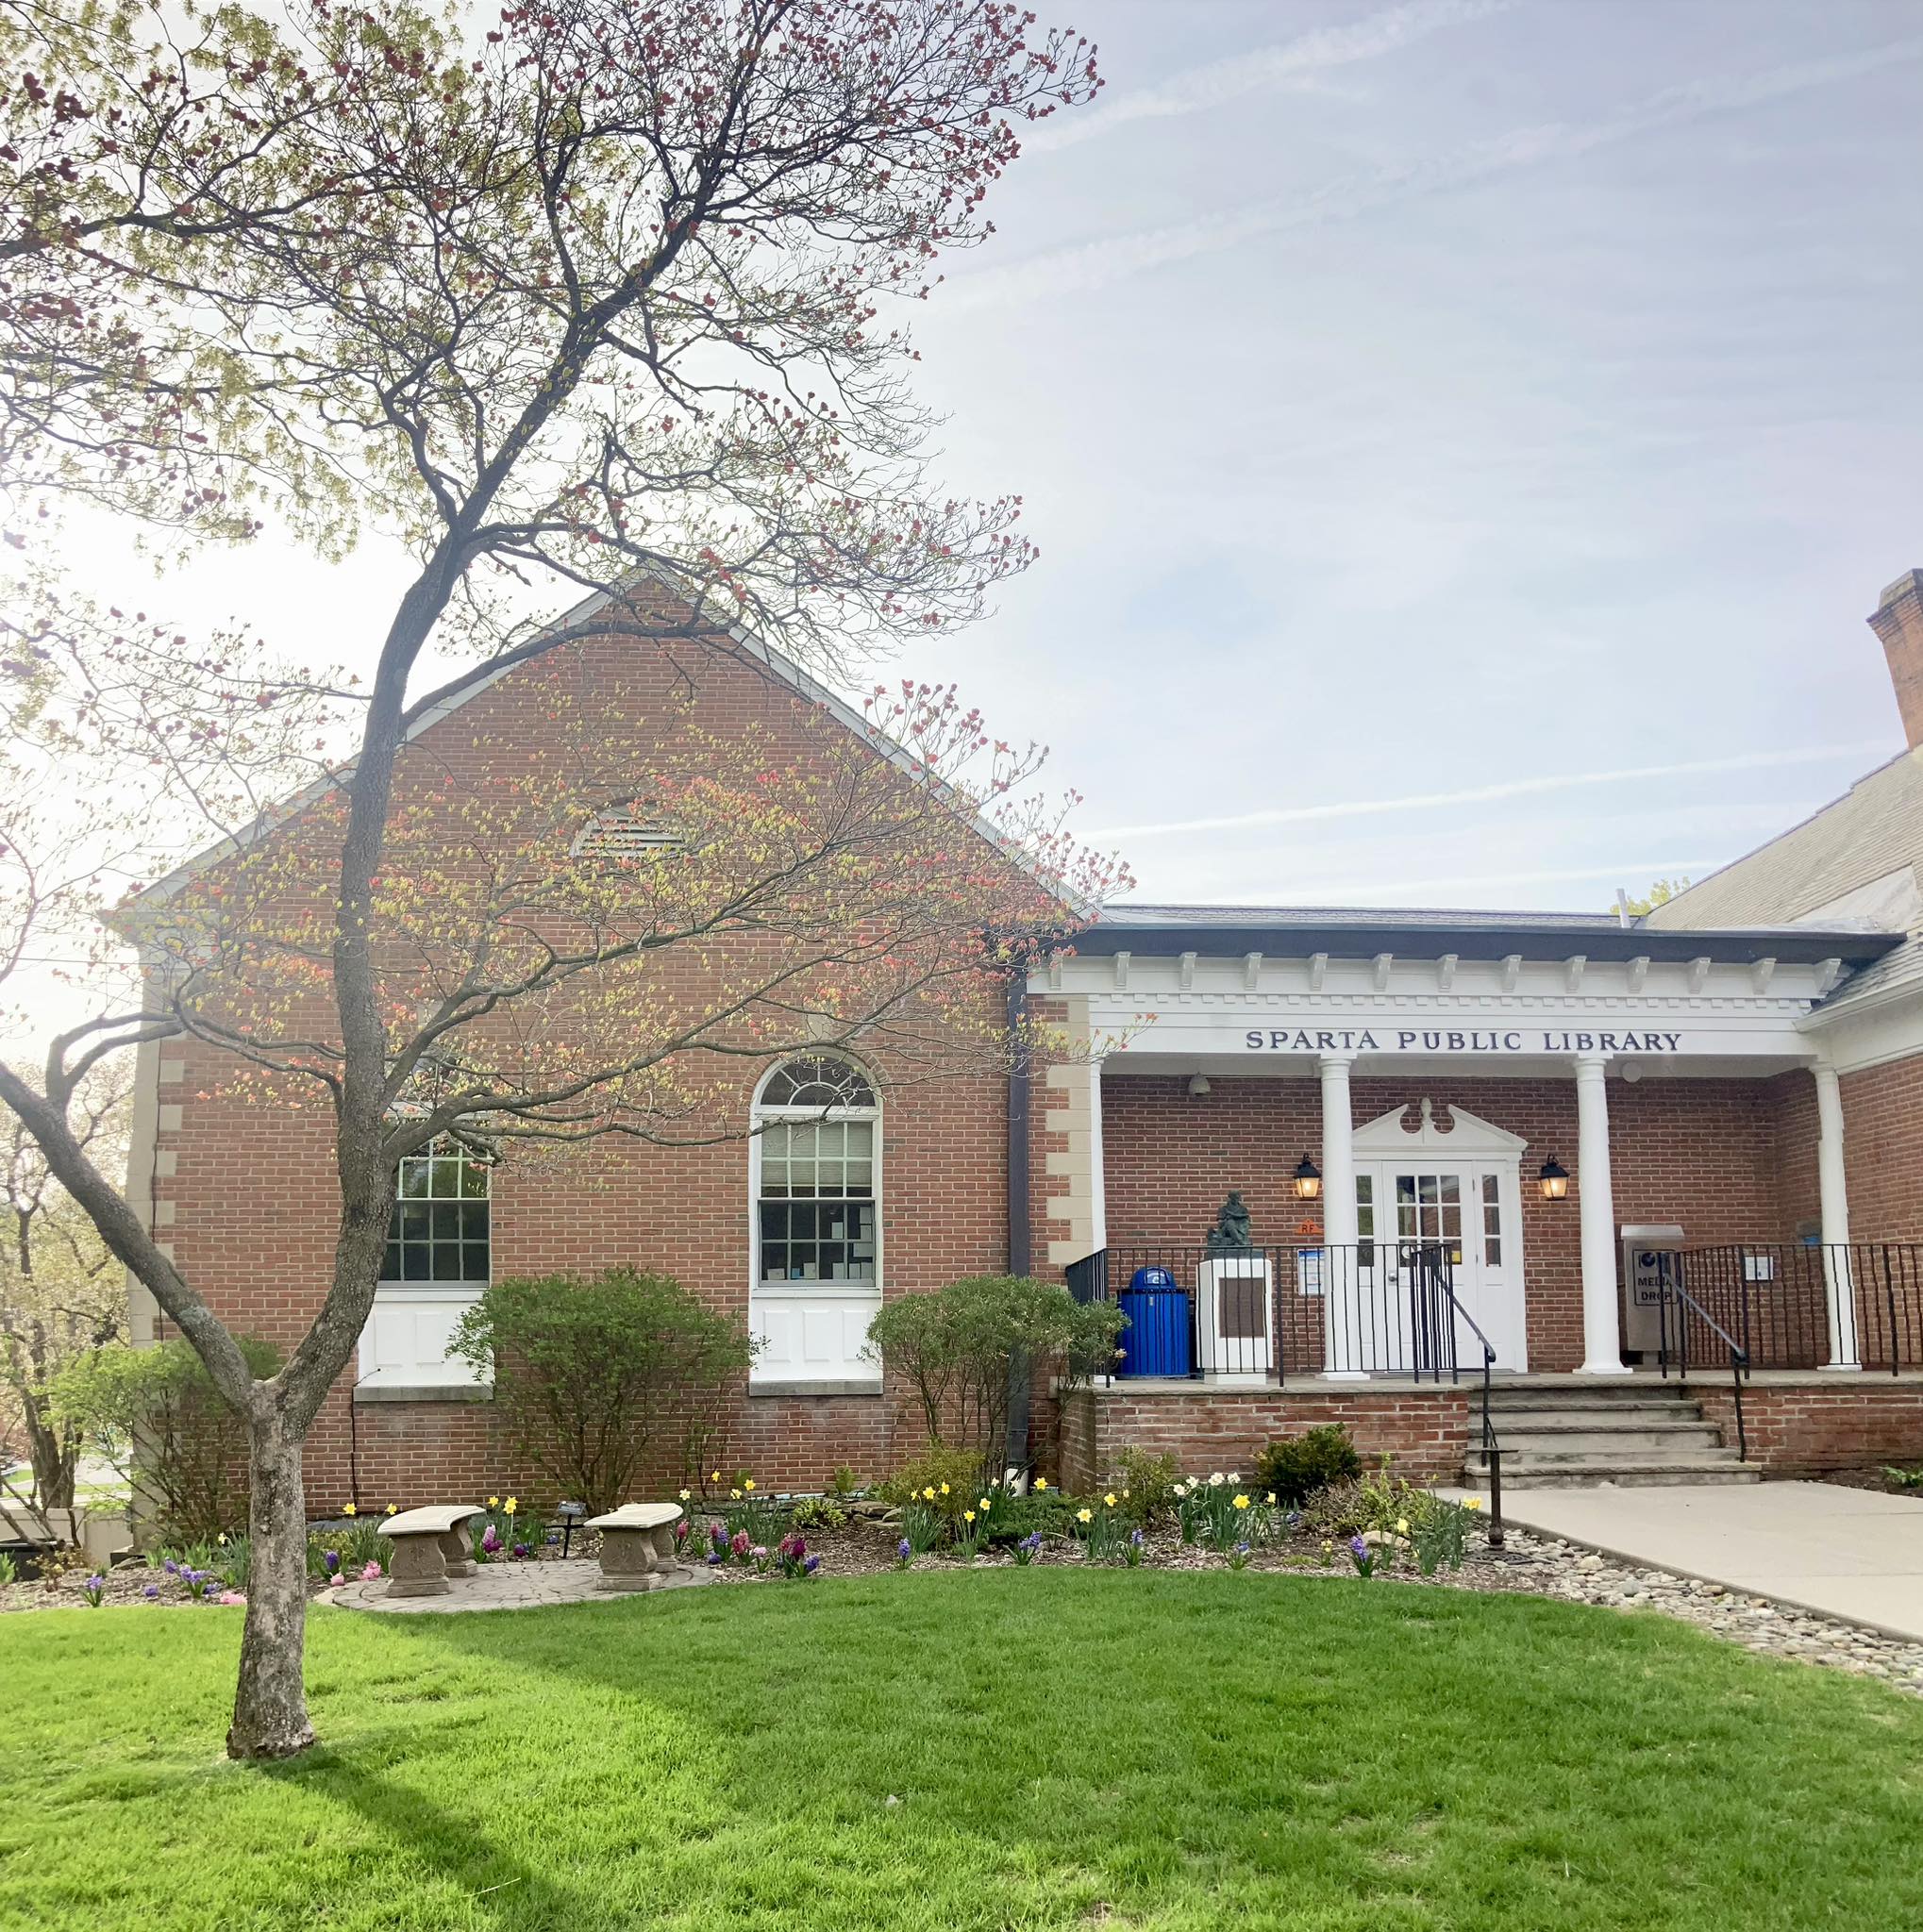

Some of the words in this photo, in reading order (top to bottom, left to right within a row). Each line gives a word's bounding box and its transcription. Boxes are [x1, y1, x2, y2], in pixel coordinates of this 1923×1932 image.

[1246, 1029, 1380, 1049] SPARTA
[1397, 1031, 1521, 1050] PUBLIC
[1543, 1031, 1681, 1051] LIBRARY
